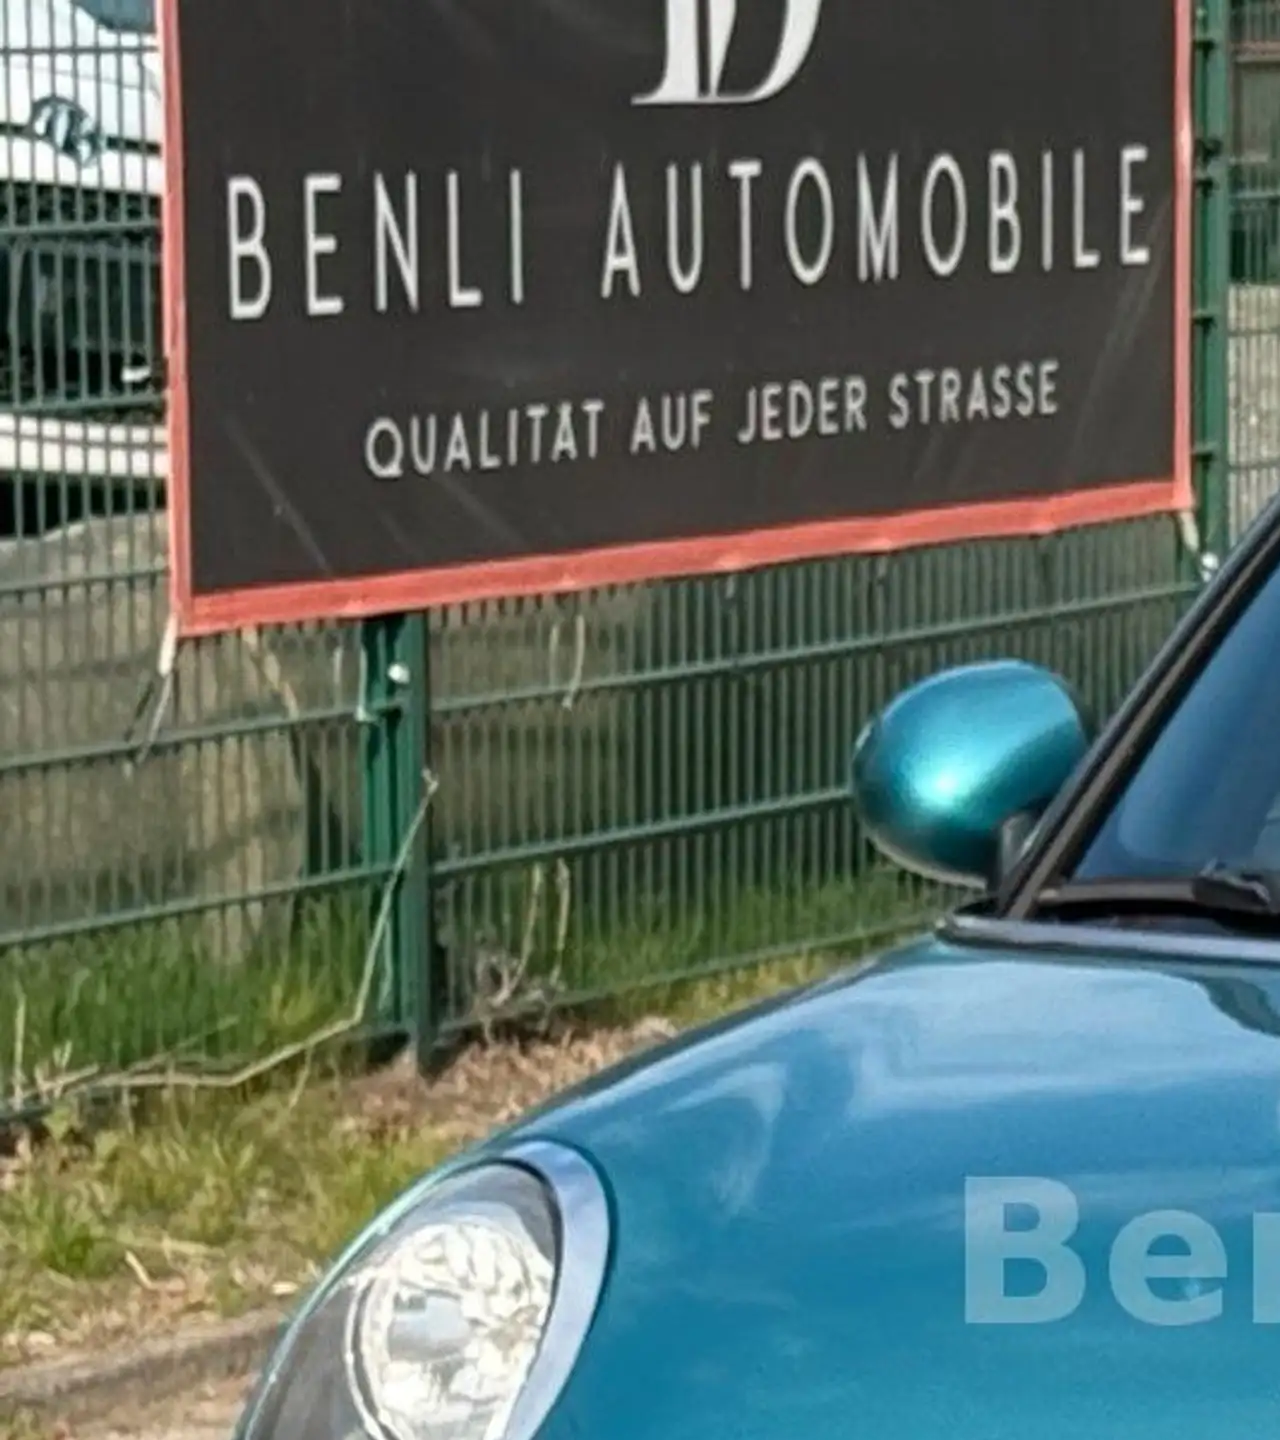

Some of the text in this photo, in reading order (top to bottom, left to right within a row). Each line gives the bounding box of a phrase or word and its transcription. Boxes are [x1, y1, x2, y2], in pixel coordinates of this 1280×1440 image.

[226, 144, 1151, 321] BENLI AUTOMOBILE
[630, 388, 713, 454] AUF
[737, 374, 868, 444] JEDER
[889, 358, 1060, 430] STRASSE
